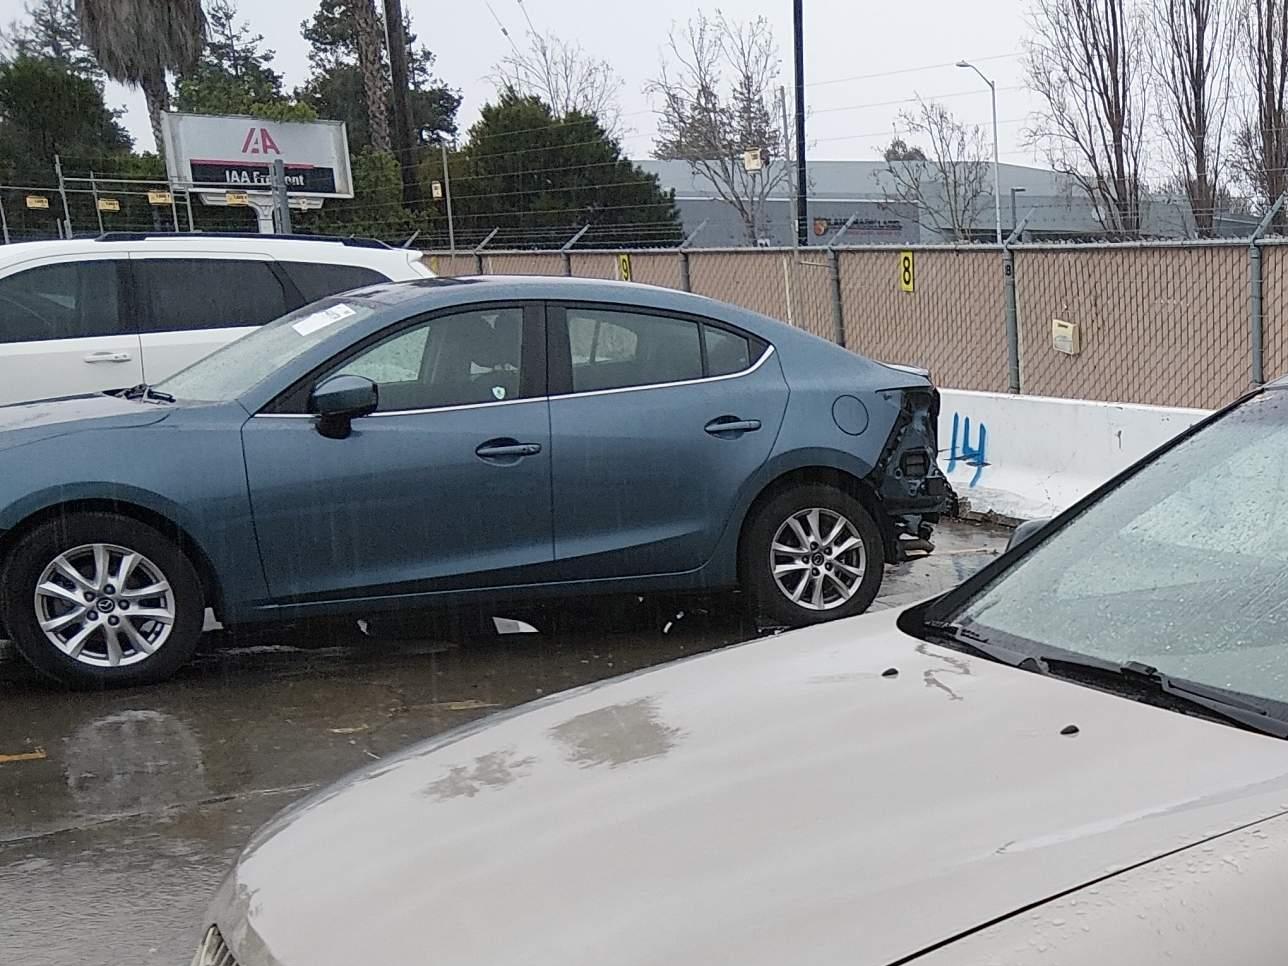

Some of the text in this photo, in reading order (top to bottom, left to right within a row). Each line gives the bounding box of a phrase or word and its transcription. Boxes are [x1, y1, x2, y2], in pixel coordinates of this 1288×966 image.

[241, 127, 281, 155] IAA
[225, 169, 304, 186] IAA Freont
[622, 258, 629, 281] 9
[902, 255, 912, 286] 8
[946, 411, 987, 489] 14
